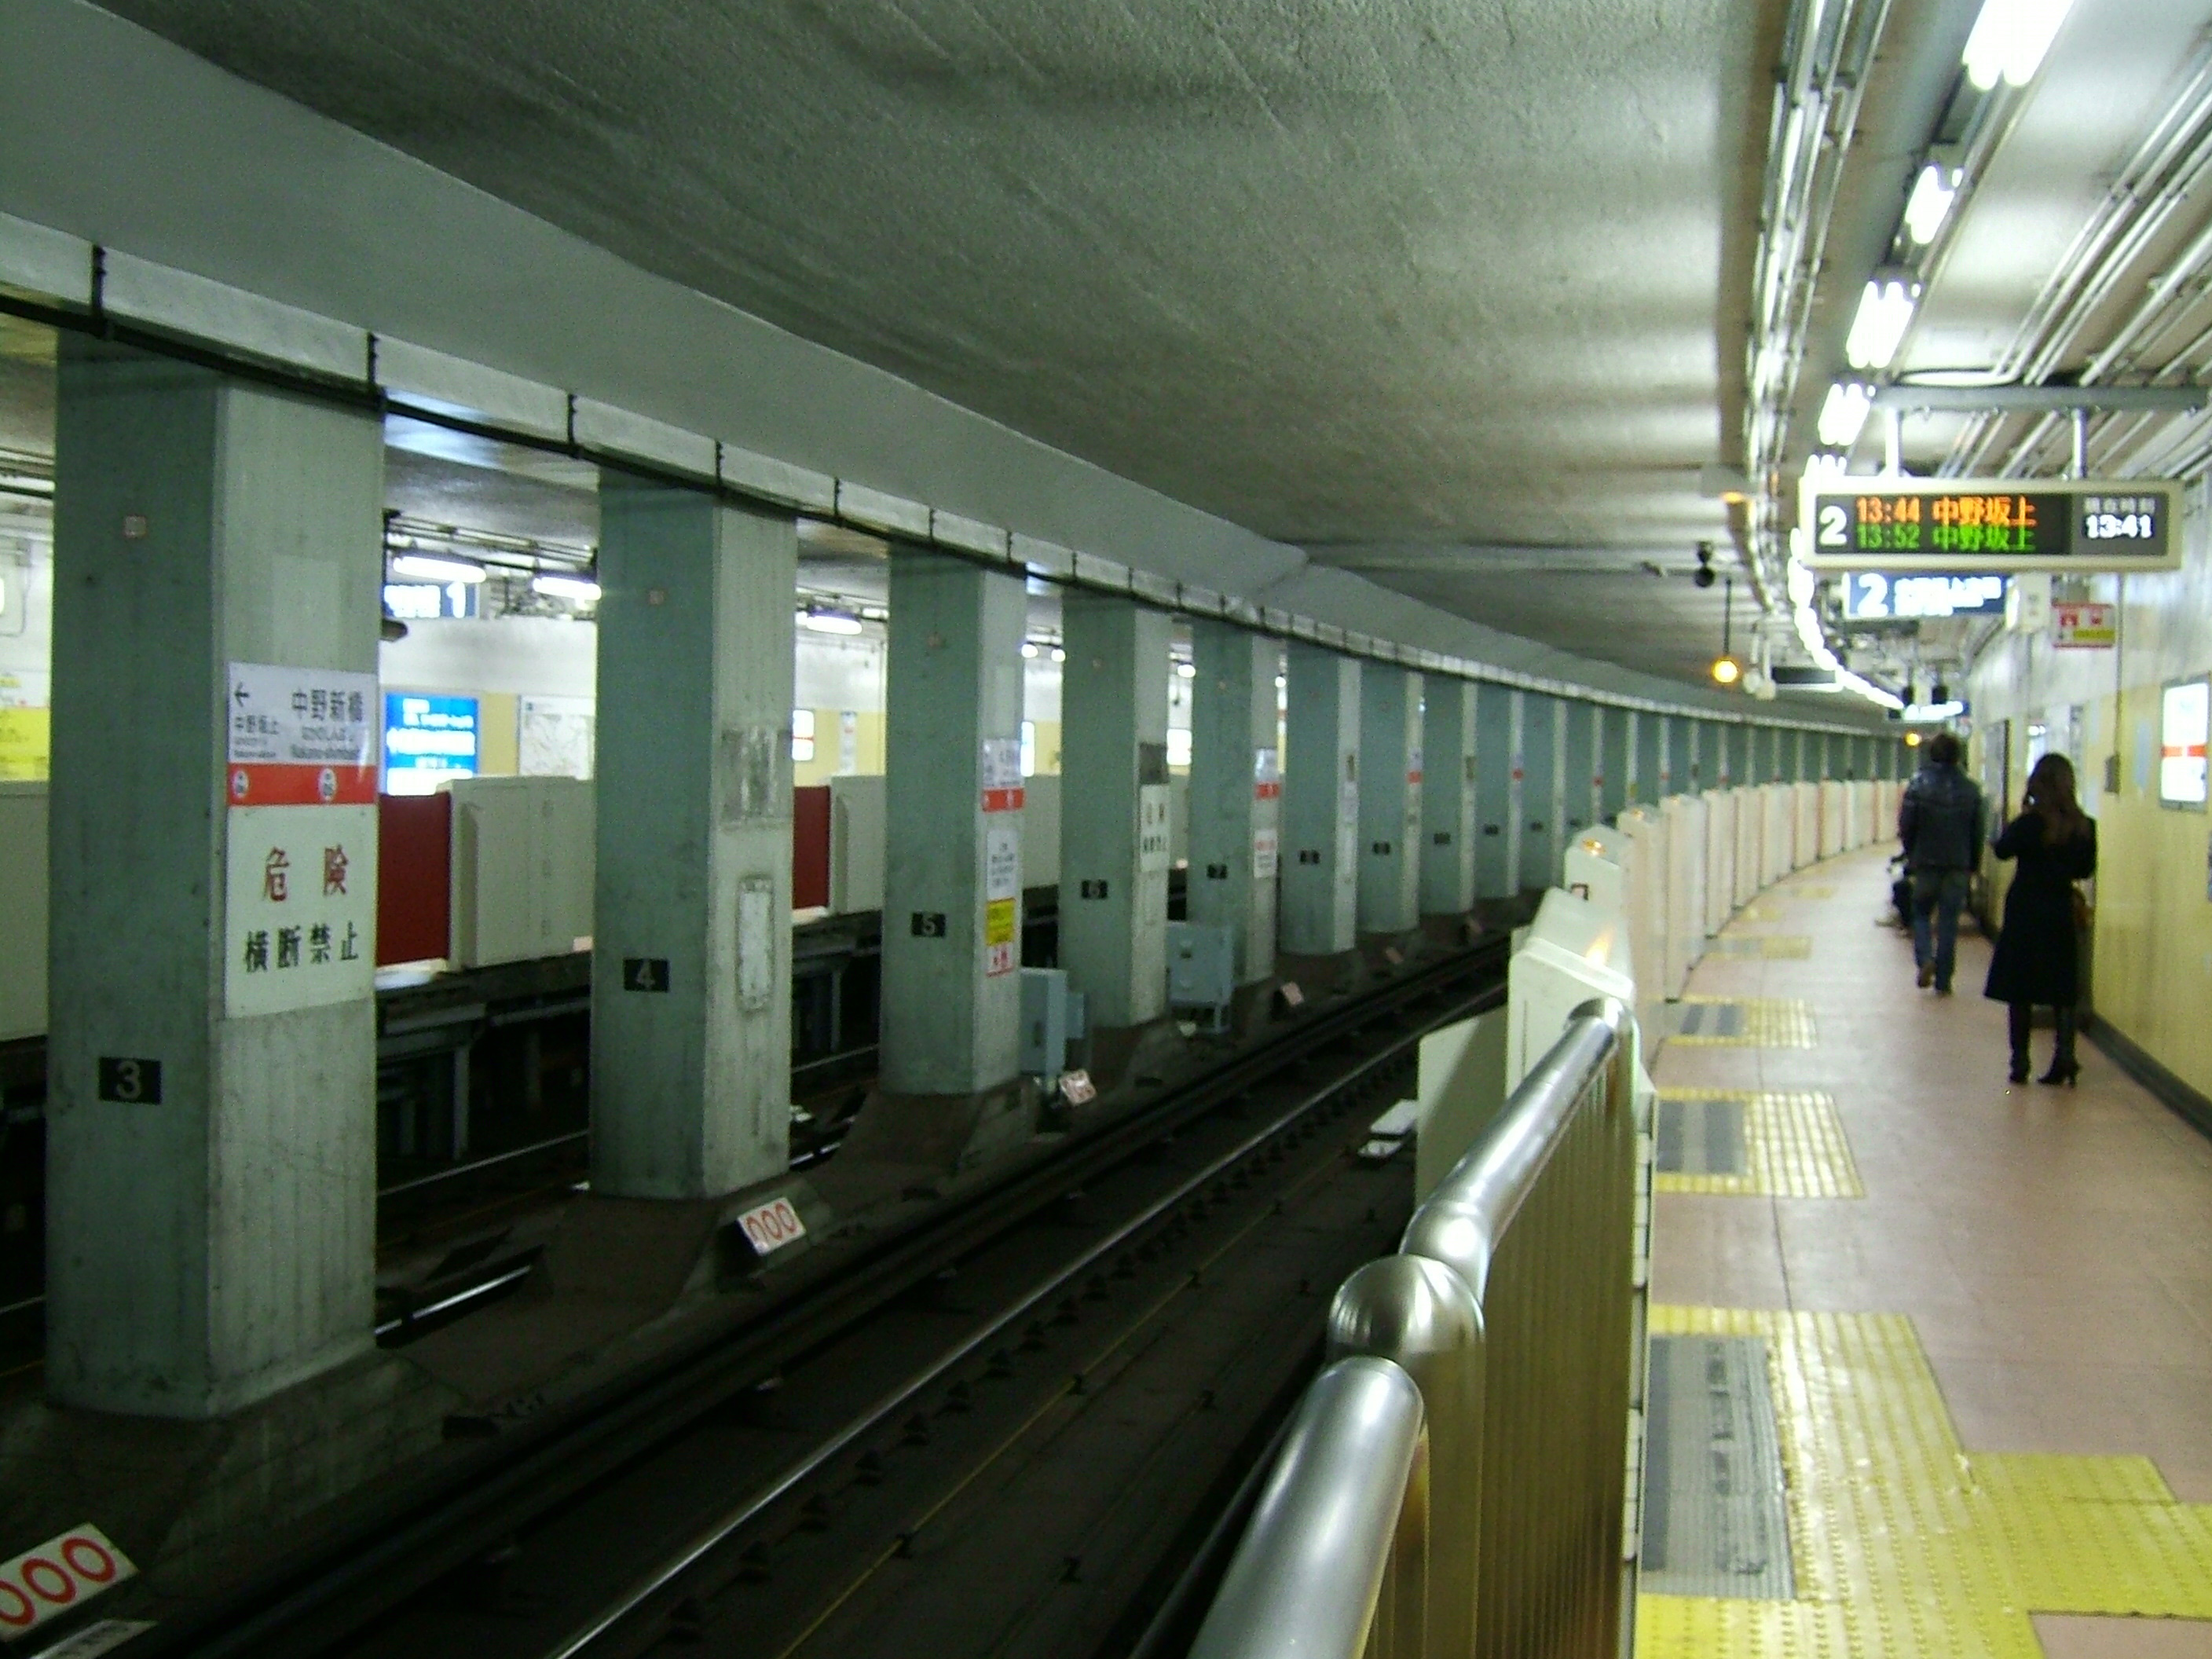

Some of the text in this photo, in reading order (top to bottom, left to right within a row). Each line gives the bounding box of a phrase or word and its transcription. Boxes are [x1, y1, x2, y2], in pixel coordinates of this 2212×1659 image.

[1818, 505, 1847, 545] 2
[1856, 496, 2037, 527] 13:44 中野坂上
[2086, 515, 2152, 538] 13:41
[1856, 523, 2036, 551] 13:52 中野坂上
[446, 581, 467, 618] 1
[1857, 573, 1888, 617] 2
[921, 913, 936, 936] 5
[245, 920, 359, 973] 横断禁止
[635, 960, 655, 989] 4
[116, 1060, 141, 1100] 3
